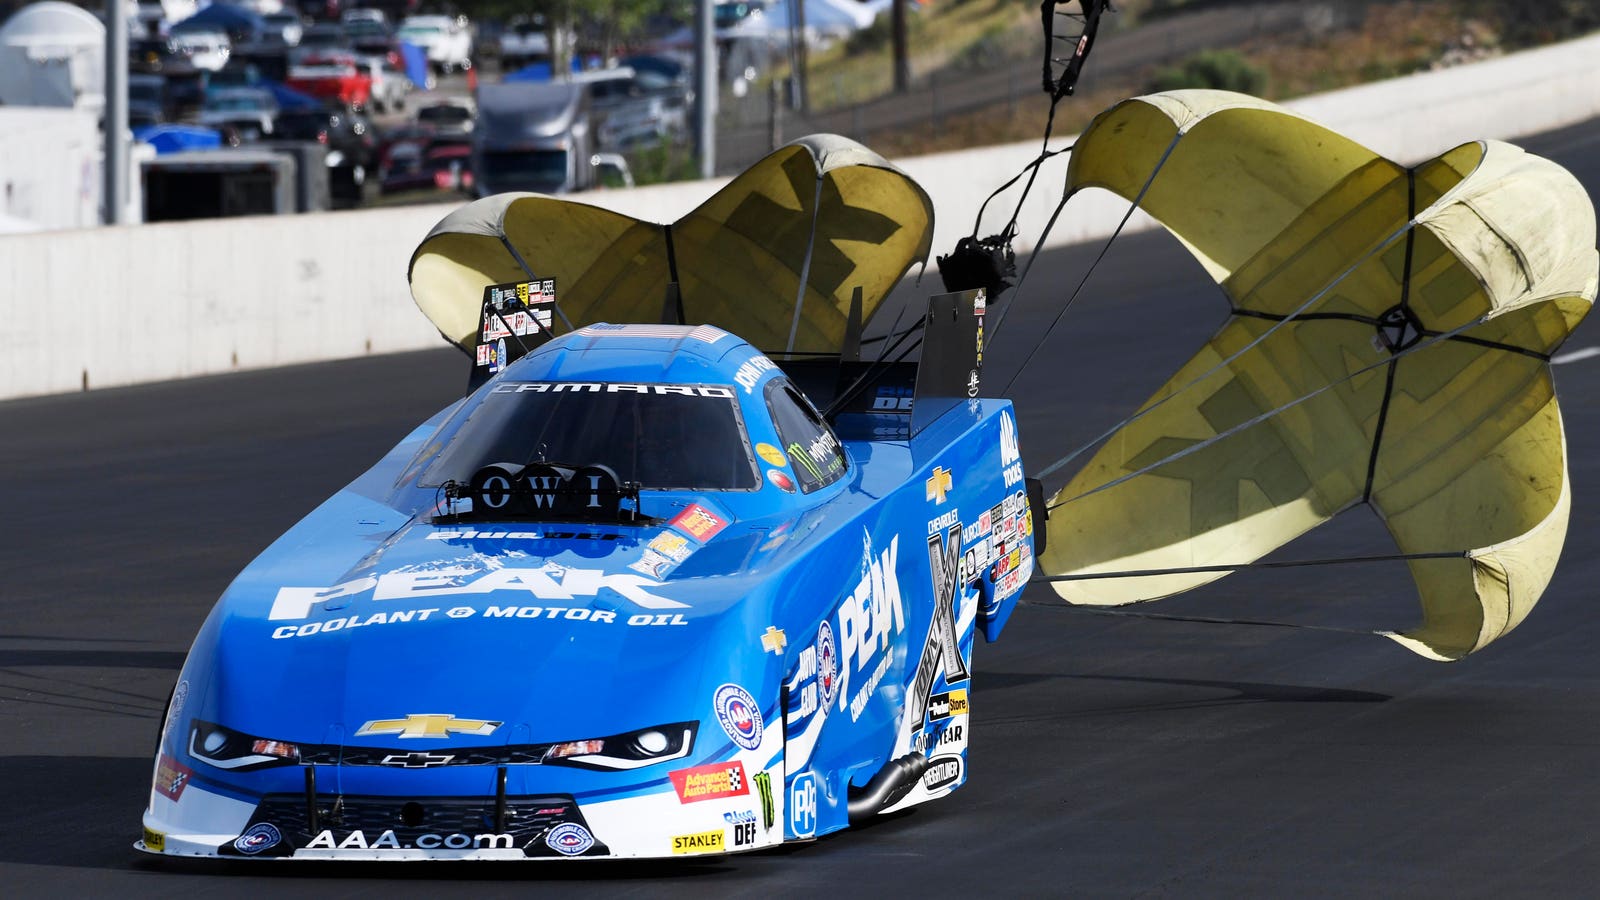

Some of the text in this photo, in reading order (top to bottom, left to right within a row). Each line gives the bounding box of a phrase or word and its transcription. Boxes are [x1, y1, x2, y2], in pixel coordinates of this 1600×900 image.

[490, 383, 734, 399] CAMARO
[1003, 462, 1023, 489] TOOLS
[928, 508, 958, 535] CHEVROLET
[268, 568, 692, 621] PEAK
[271, 608, 441, 640] COOLANT
[483, 606, 617, 624] MOTOR
[627, 613, 690, 627] OIL
[838, 533, 905, 713] PEAK
[799, 645, 817, 682] AUTO
[915, 628, 938, 713] JOHN
[800, 682, 818, 718] CLUB
[949, 698, 966, 712] Store
[683, 782, 707, 798] Auto
[686, 768, 729, 785] Advance
[305, 829, 514, 849] AAA.com
[674, 833, 723, 848] STANLEY
[734, 823, 757, 846] DEF
